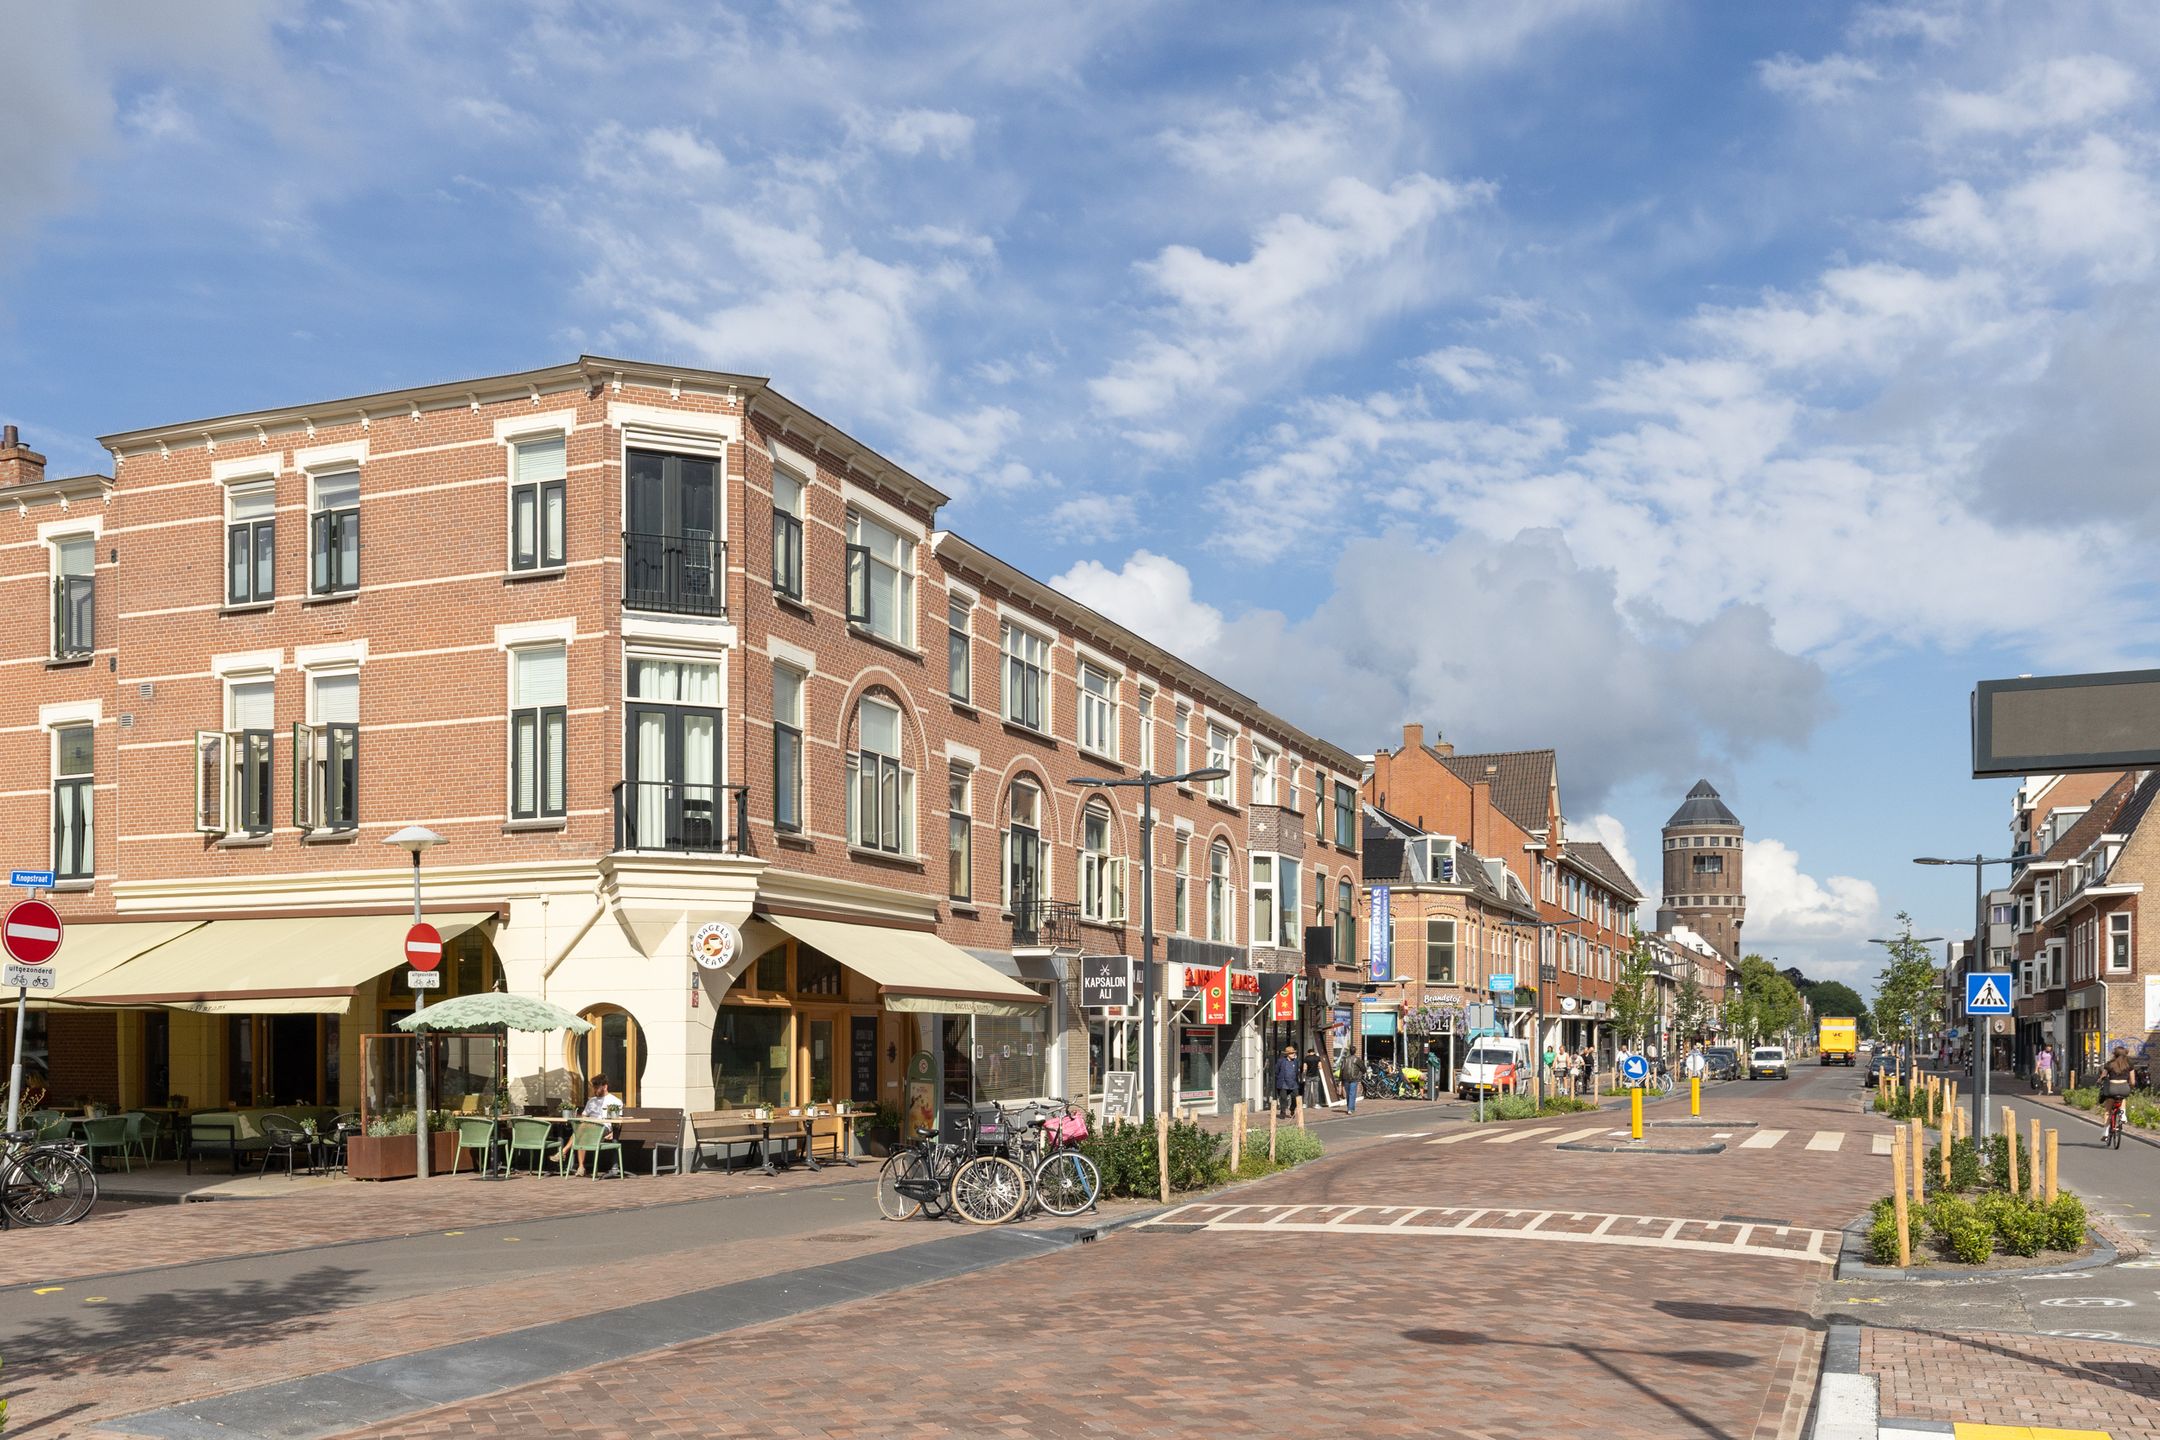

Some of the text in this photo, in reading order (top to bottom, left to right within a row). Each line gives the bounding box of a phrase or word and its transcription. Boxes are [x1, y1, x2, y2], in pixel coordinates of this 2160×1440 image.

[16, 873, 48, 883] Knopstraat
[1372, 889, 1381, 963] ZUIVERWAS
[697, 924, 729, 940] BAGELS
[699, 953, 729, 966] BEANS
[9, 965, 53, 974] uitgezonderd
[1084, 976, 1126, 988] KAPSALON
[1099, 988, 1112, 999] ALI
[1423, 994, 1462, 1004] Brandstof
